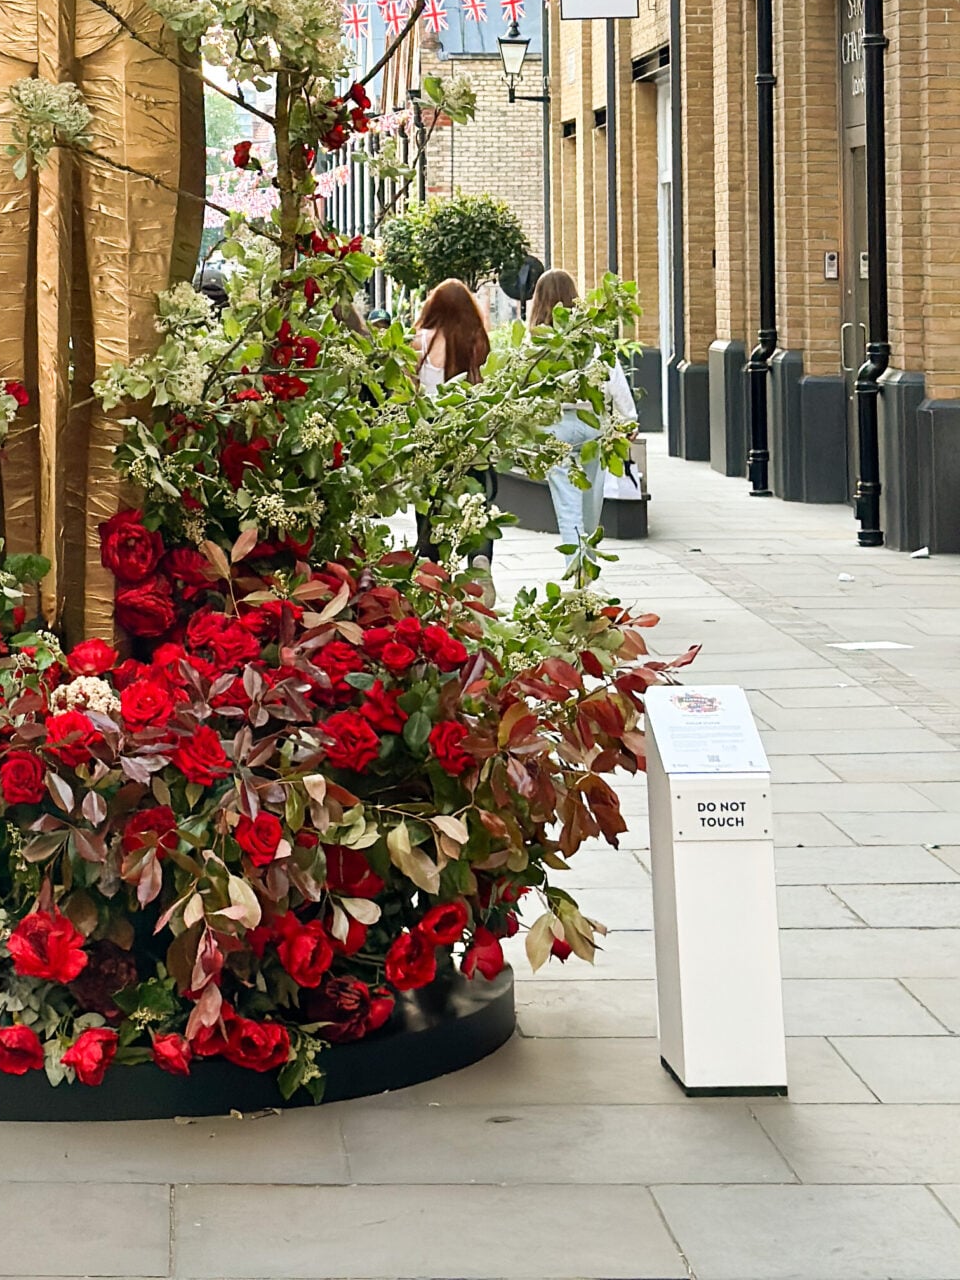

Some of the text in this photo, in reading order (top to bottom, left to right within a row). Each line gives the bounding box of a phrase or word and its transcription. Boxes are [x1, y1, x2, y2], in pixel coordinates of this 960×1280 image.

[697, 801, 746, 812] DO NOT
[699, 816, 744, 827] TOUCH
